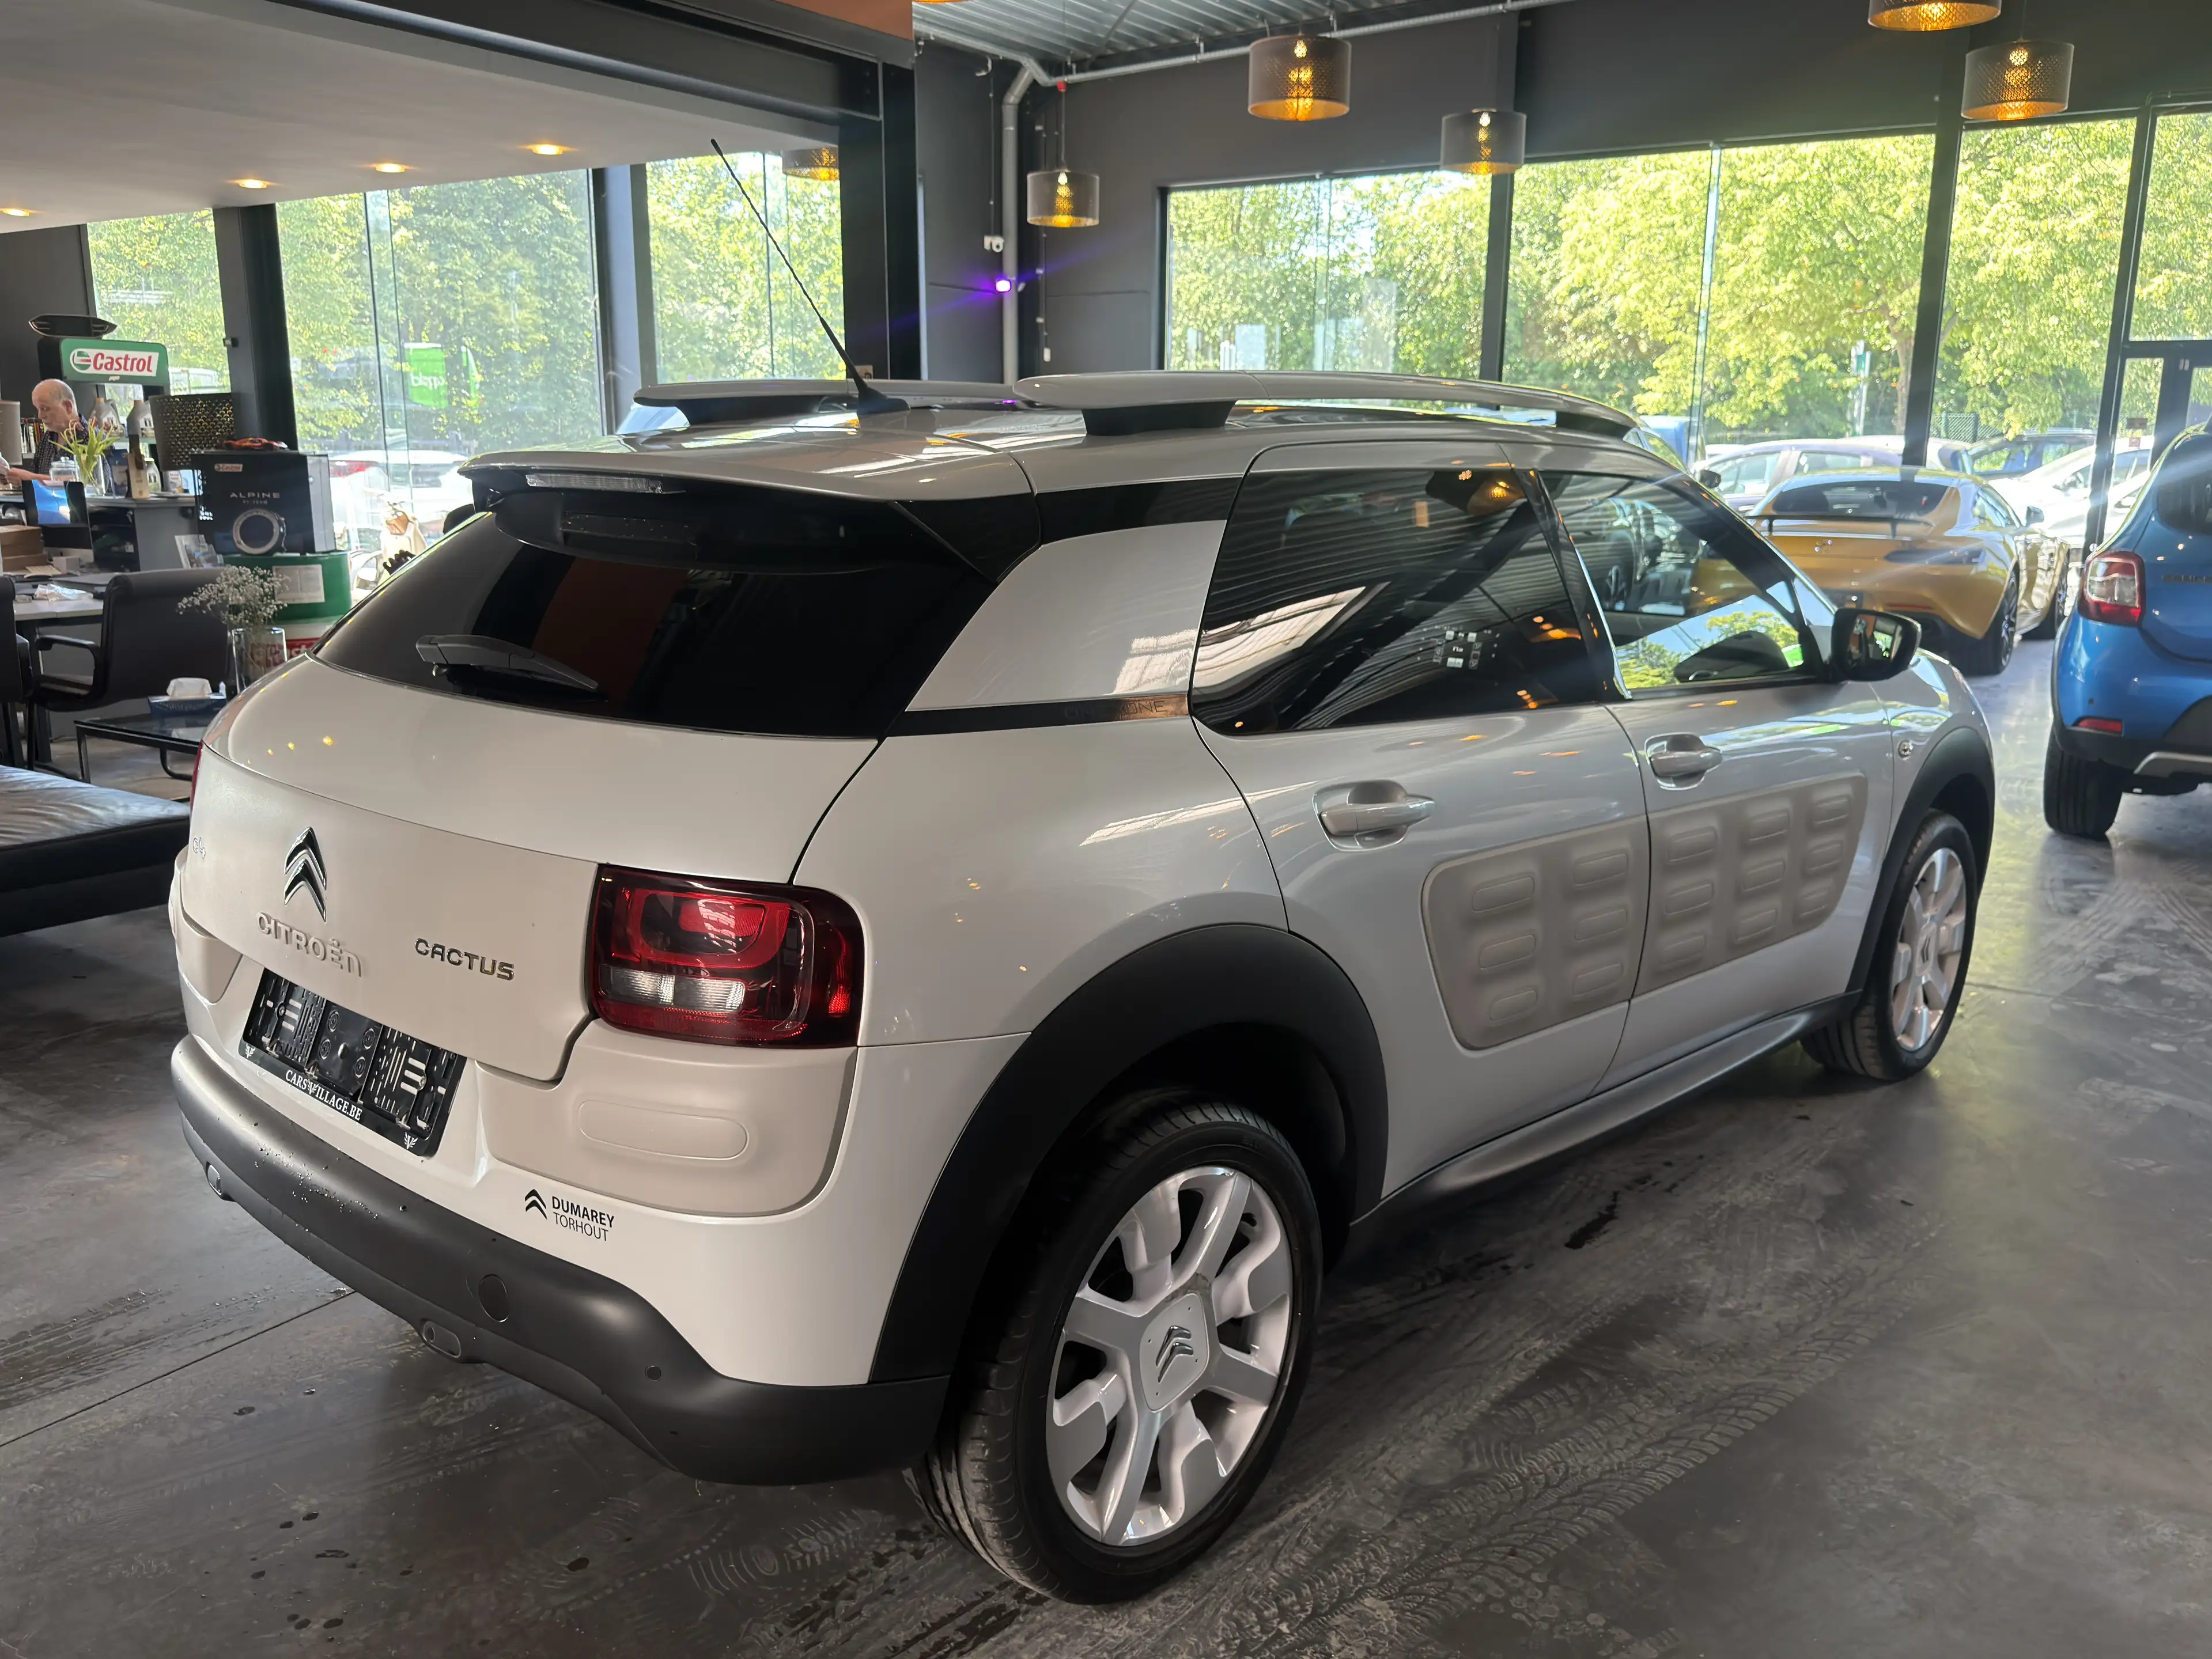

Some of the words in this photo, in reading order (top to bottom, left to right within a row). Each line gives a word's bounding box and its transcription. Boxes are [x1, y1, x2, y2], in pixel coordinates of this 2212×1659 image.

[93, 353, 153, 373] Castrol
[193, 836, 206, 859] C4
[414, 938, 515, 980] CACTUS
[552, 1196, 615, 1228] DUMAREY
[553, 1211, 608, 1241] TORHOUT
